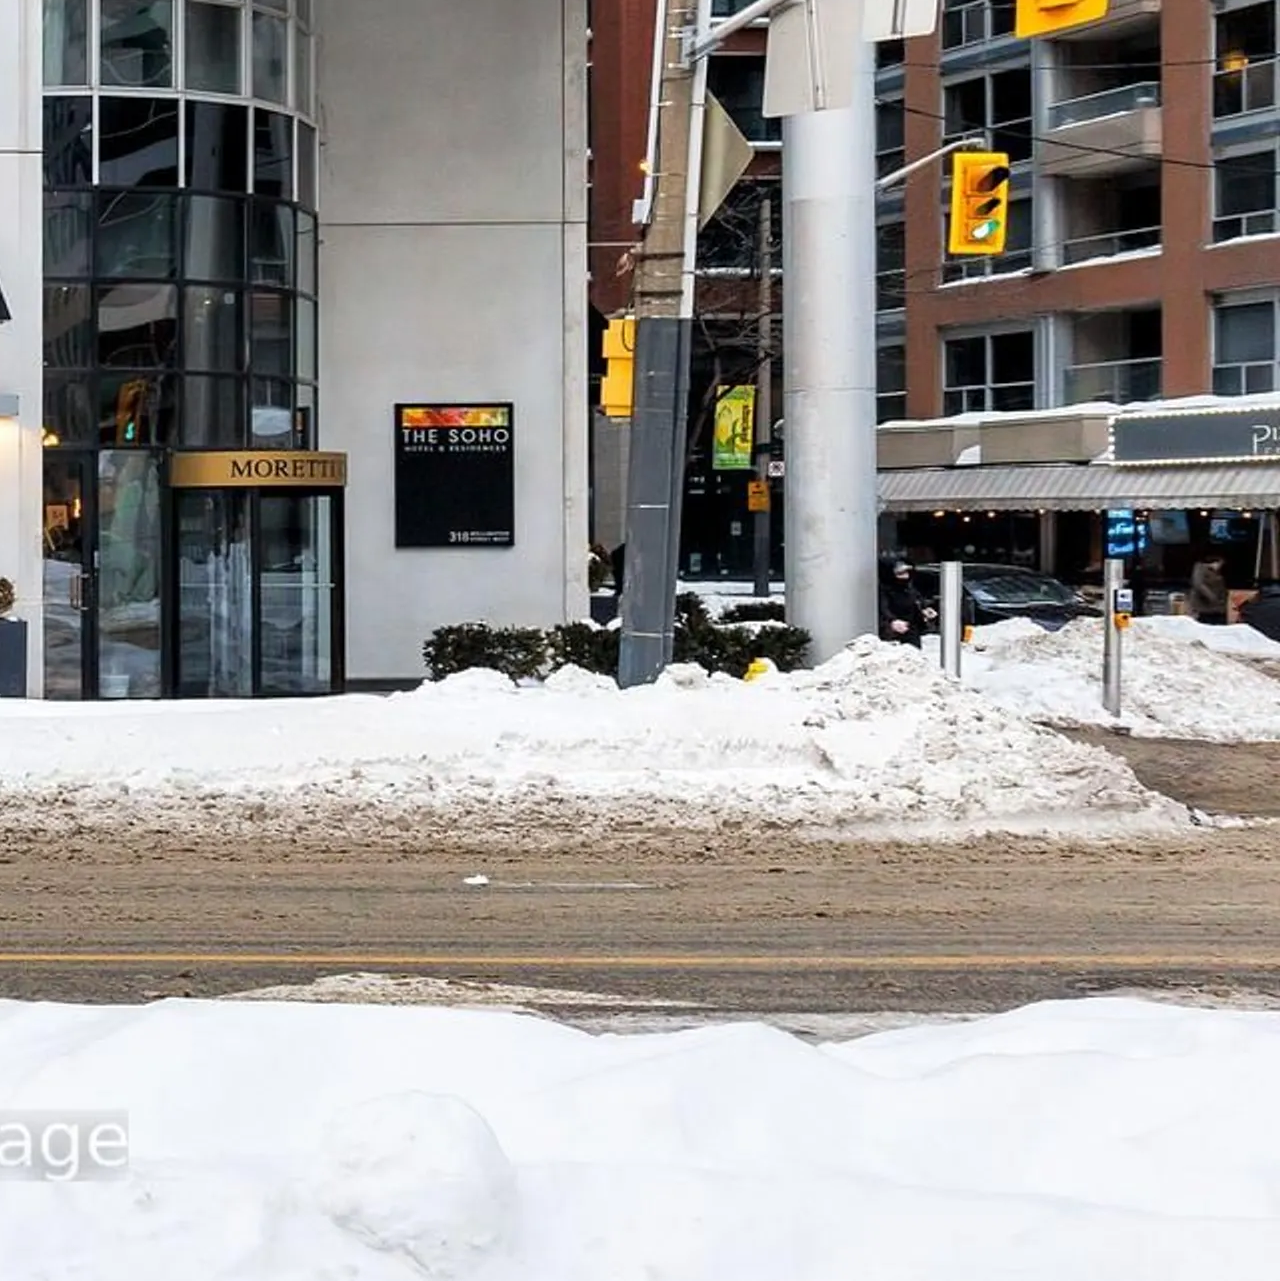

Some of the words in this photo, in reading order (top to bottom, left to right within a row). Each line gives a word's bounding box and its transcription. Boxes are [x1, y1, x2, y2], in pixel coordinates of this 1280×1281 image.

[402, 428, 438, 443] THE
[448, 428, 510, 443] SOHO
[230, 458, 337, 478] MORETTI
